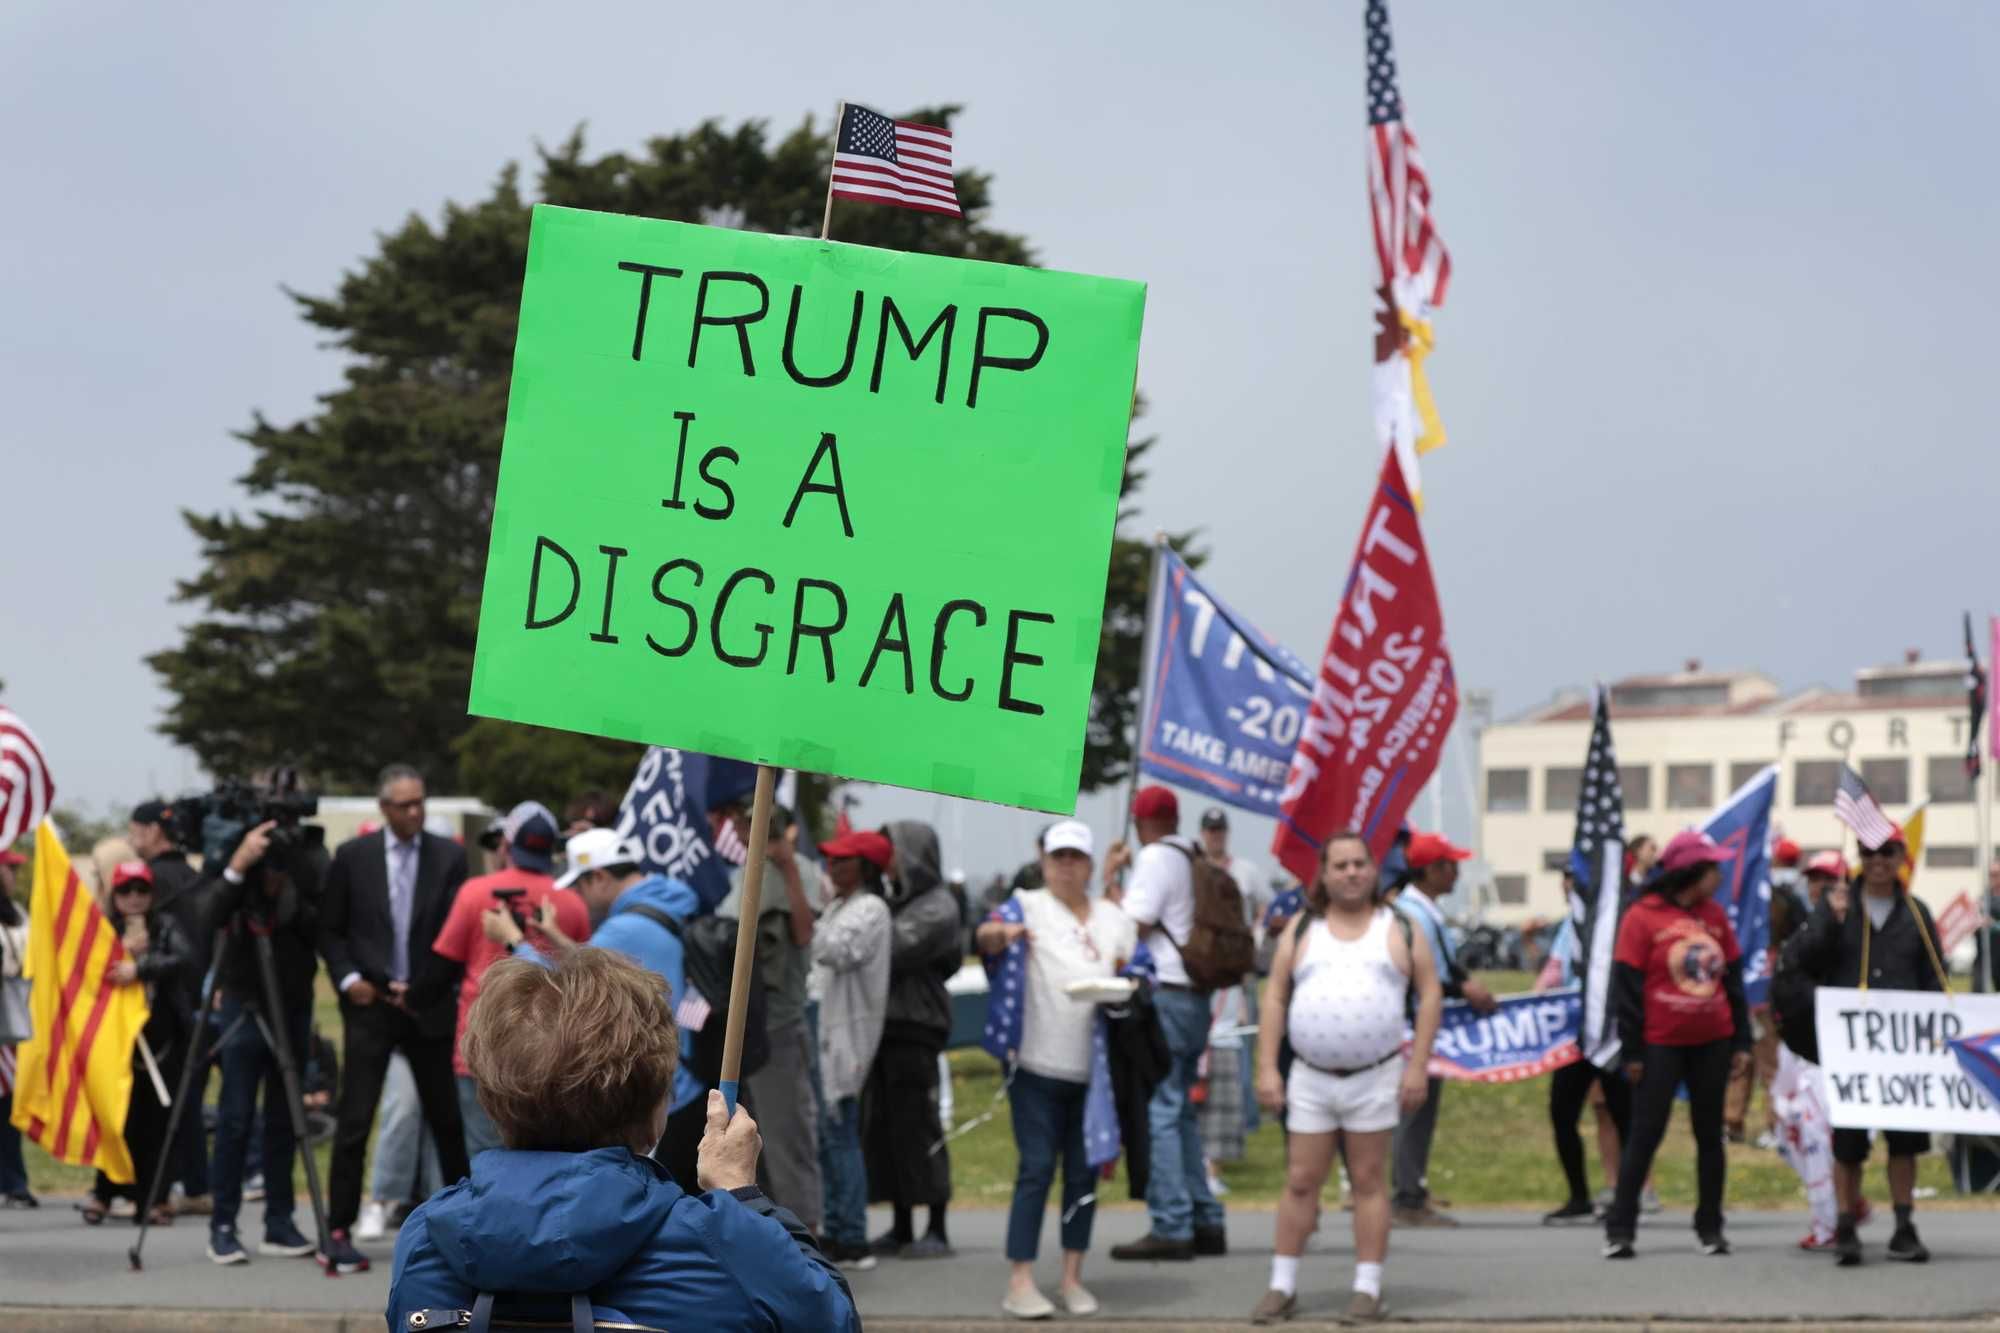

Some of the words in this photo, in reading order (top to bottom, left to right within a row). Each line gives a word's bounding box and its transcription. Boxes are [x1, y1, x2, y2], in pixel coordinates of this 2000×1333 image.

[618, 261, 1050, 409] TRUMP
[782, 431, 855, 538] A
[524, 535, 1056, 716] DISGRACE
[1161, 719, 1227, 766] TAKE
[1778, 717, 1970, 750] FORT
[1432, 1000, 1569, 1058] RUMP
[1838, 1009, 1962, 1057] TRUMP
[1831, 1071, 1870, 1104] WE
[1877, 1072, 1935, 1109] LOVE
